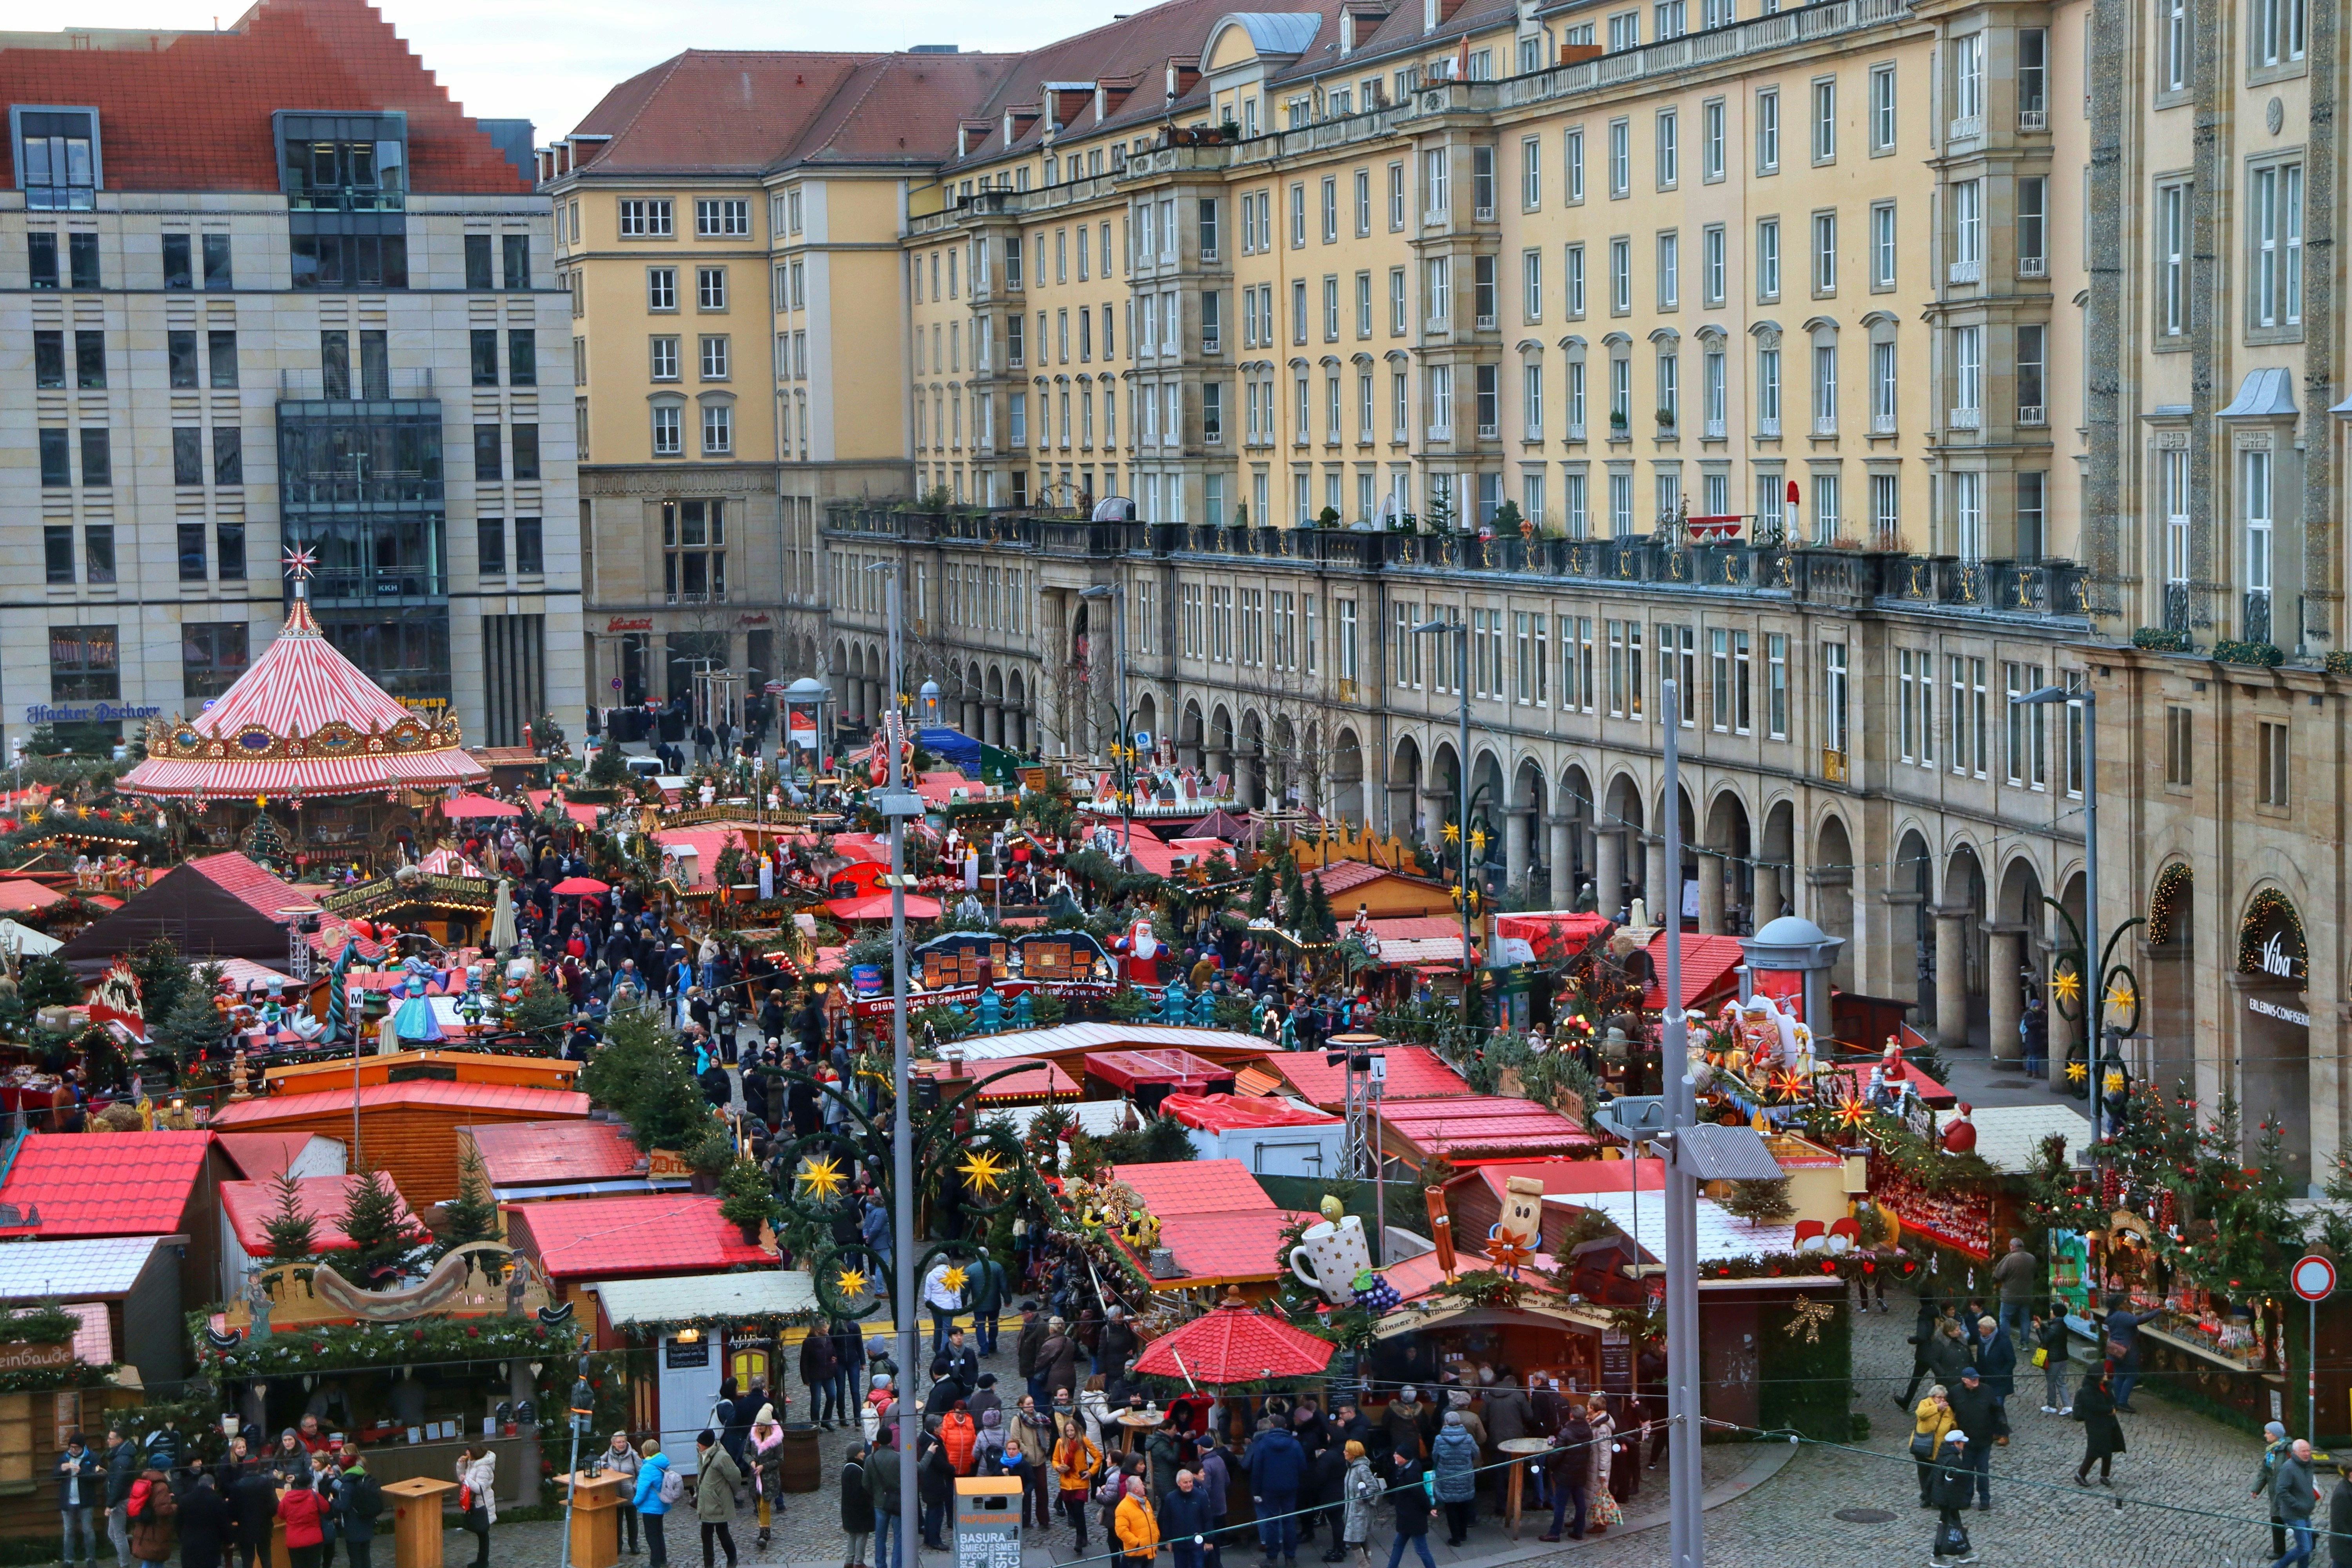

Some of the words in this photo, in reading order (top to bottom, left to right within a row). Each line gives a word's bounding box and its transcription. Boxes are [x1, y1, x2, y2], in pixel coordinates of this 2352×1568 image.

[27, 704, 89, 724] Hacker
[94, 702, 160, 724] Pschorr
[2263, 931, 2291, 978] Viba
[858, 970, 878, 978] Unser
[351, 993, 361, 1004] M
[870, 998, 926, 1012] Glüheine
[927, 995, 936, 1005] &
[938, 988, 1005, 1004] Spezialien
[1377, 1066, 1384, 1077] L
[960, 1513, 1021, 1524] PAPIERKORB
[960, 1533, 1006, 1543] BASURA
[995, 1543, 1020, 1551] SMETI
